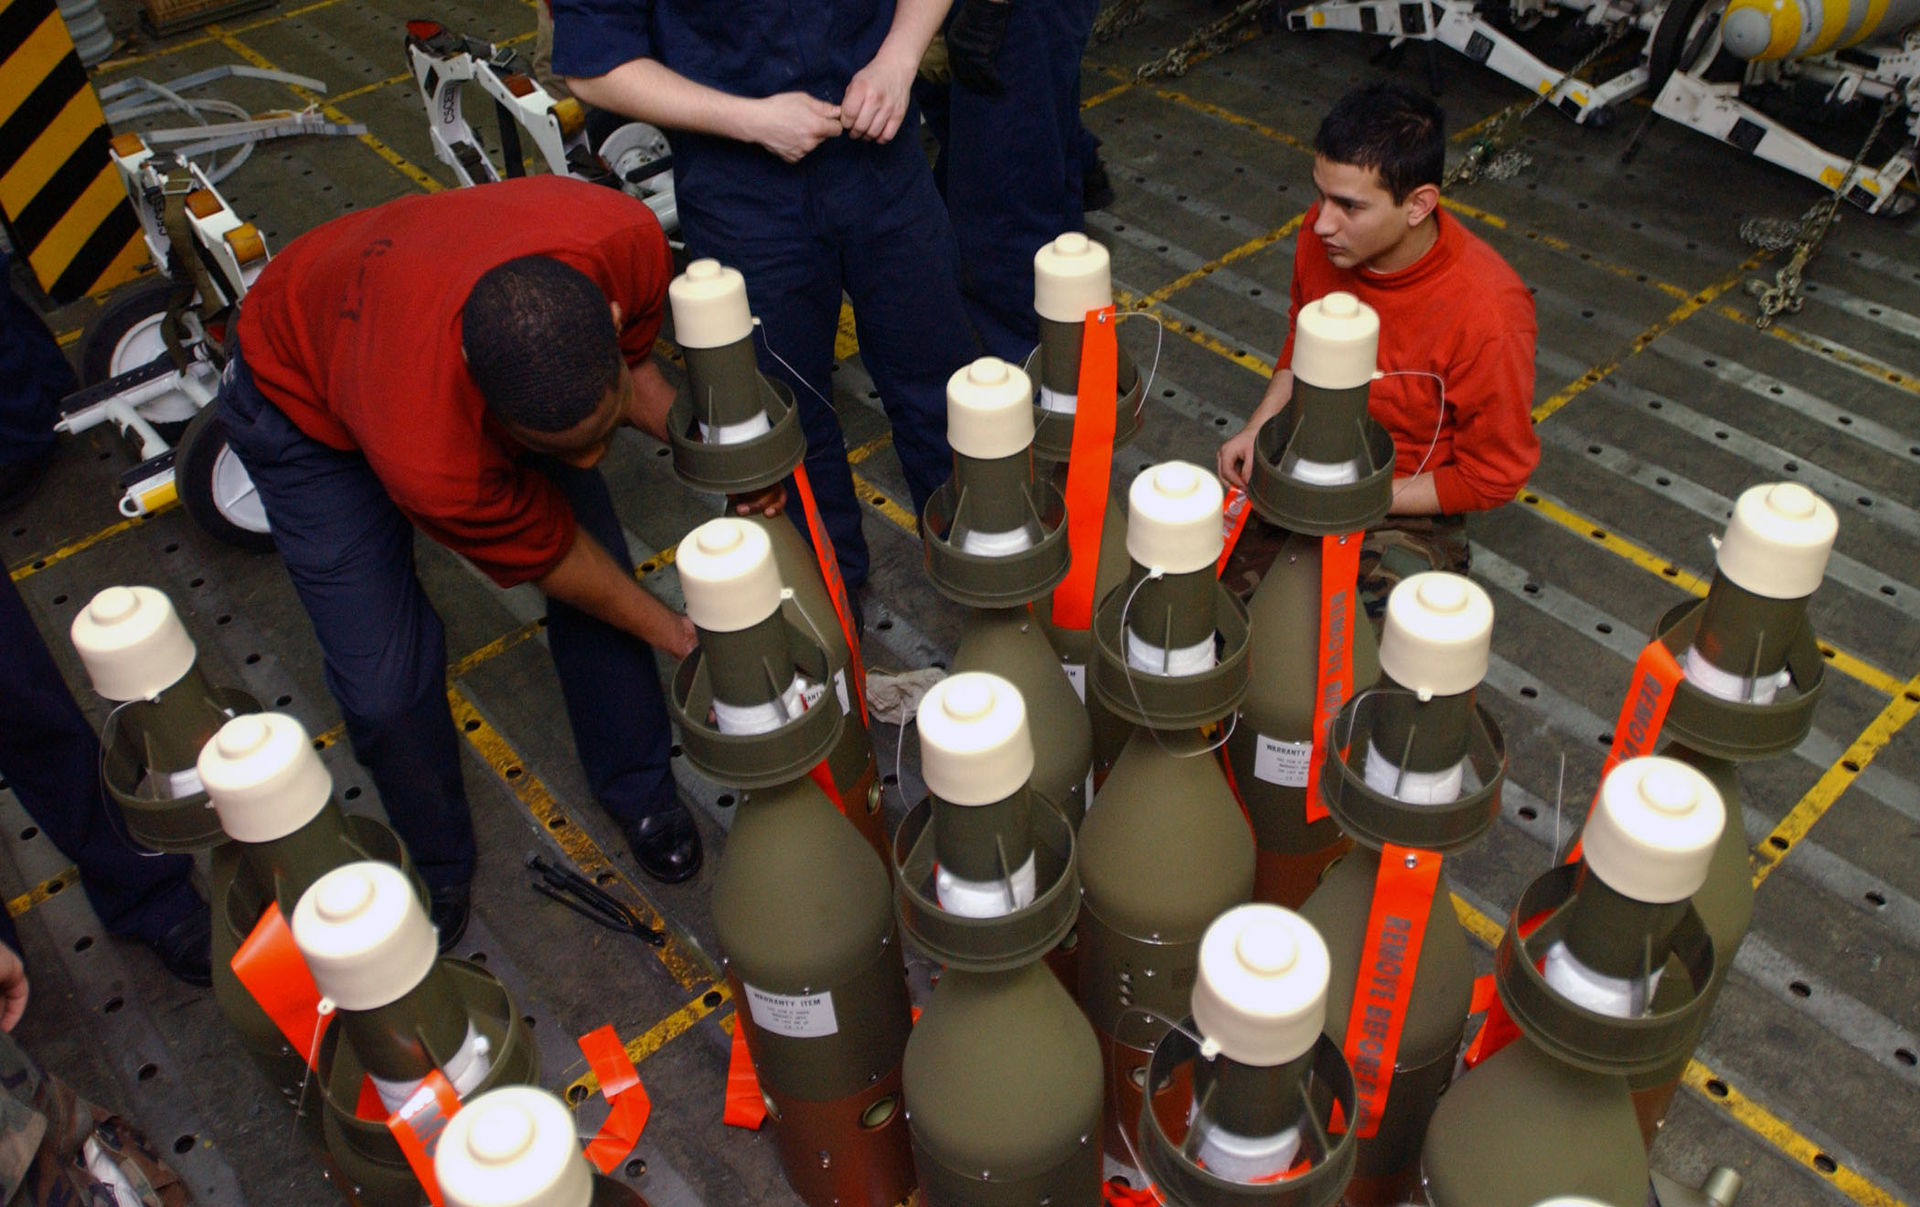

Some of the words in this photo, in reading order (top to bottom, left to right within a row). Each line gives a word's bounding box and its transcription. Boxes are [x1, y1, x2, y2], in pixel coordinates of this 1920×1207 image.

[1327, 590, 1347, 676] REMOVE
[1266, 744, 1306, 757] WARRANTY
[1369, 914, 1412, 1002] REMOVE
[754, 993, 795, 1007] WARRANTY
[800, 999, 821, 1007] ITEM
[1354, 1004, 1393, 1079] BEFORE
